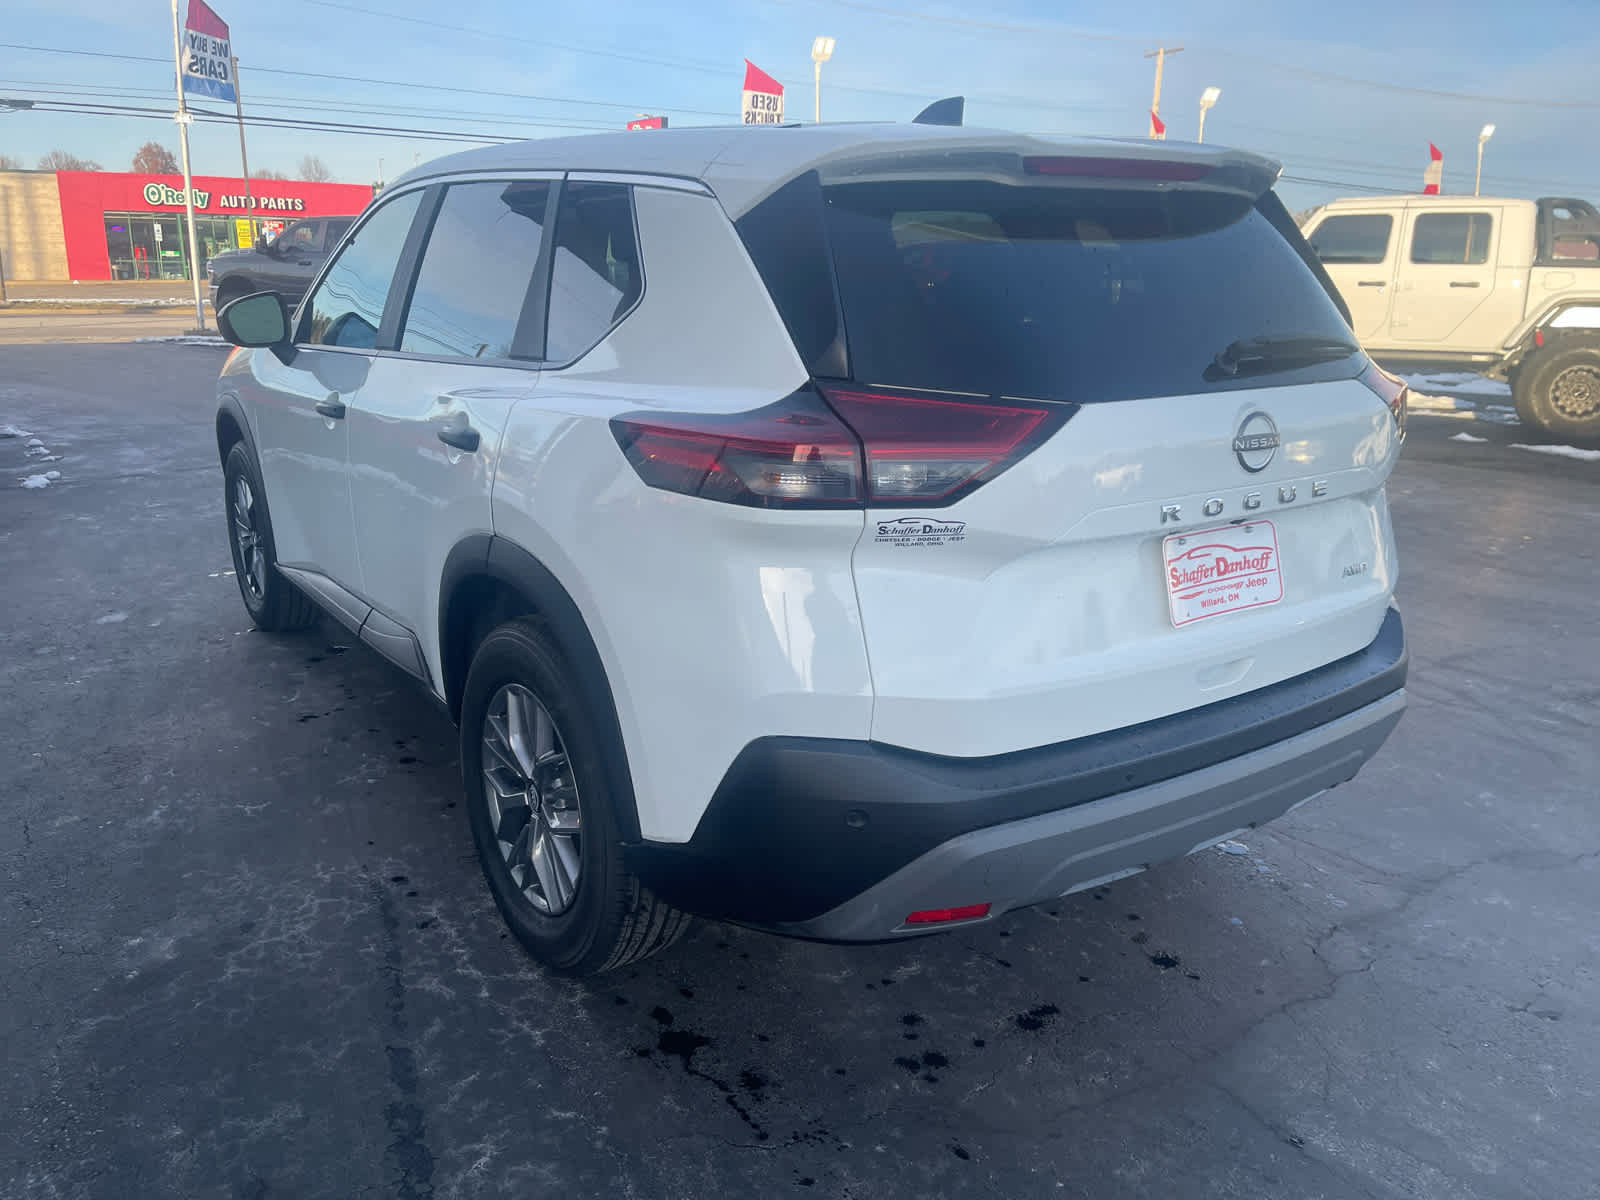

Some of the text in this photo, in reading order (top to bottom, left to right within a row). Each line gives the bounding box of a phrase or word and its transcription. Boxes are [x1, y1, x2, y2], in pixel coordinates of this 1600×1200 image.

[260, 197, 304, 211] PARTS
[1234, 436, 1281, 450] NISSAN
[1160, 480, 1328, 523] ROGUE
[878, 524, 965, 537] Schaffer Danhoff
[1170, 561, 1216, 588] Schaffer
[1215, 551, 1273, 577] Danhoff
[1245, 576, 1268, 589] Jeep
